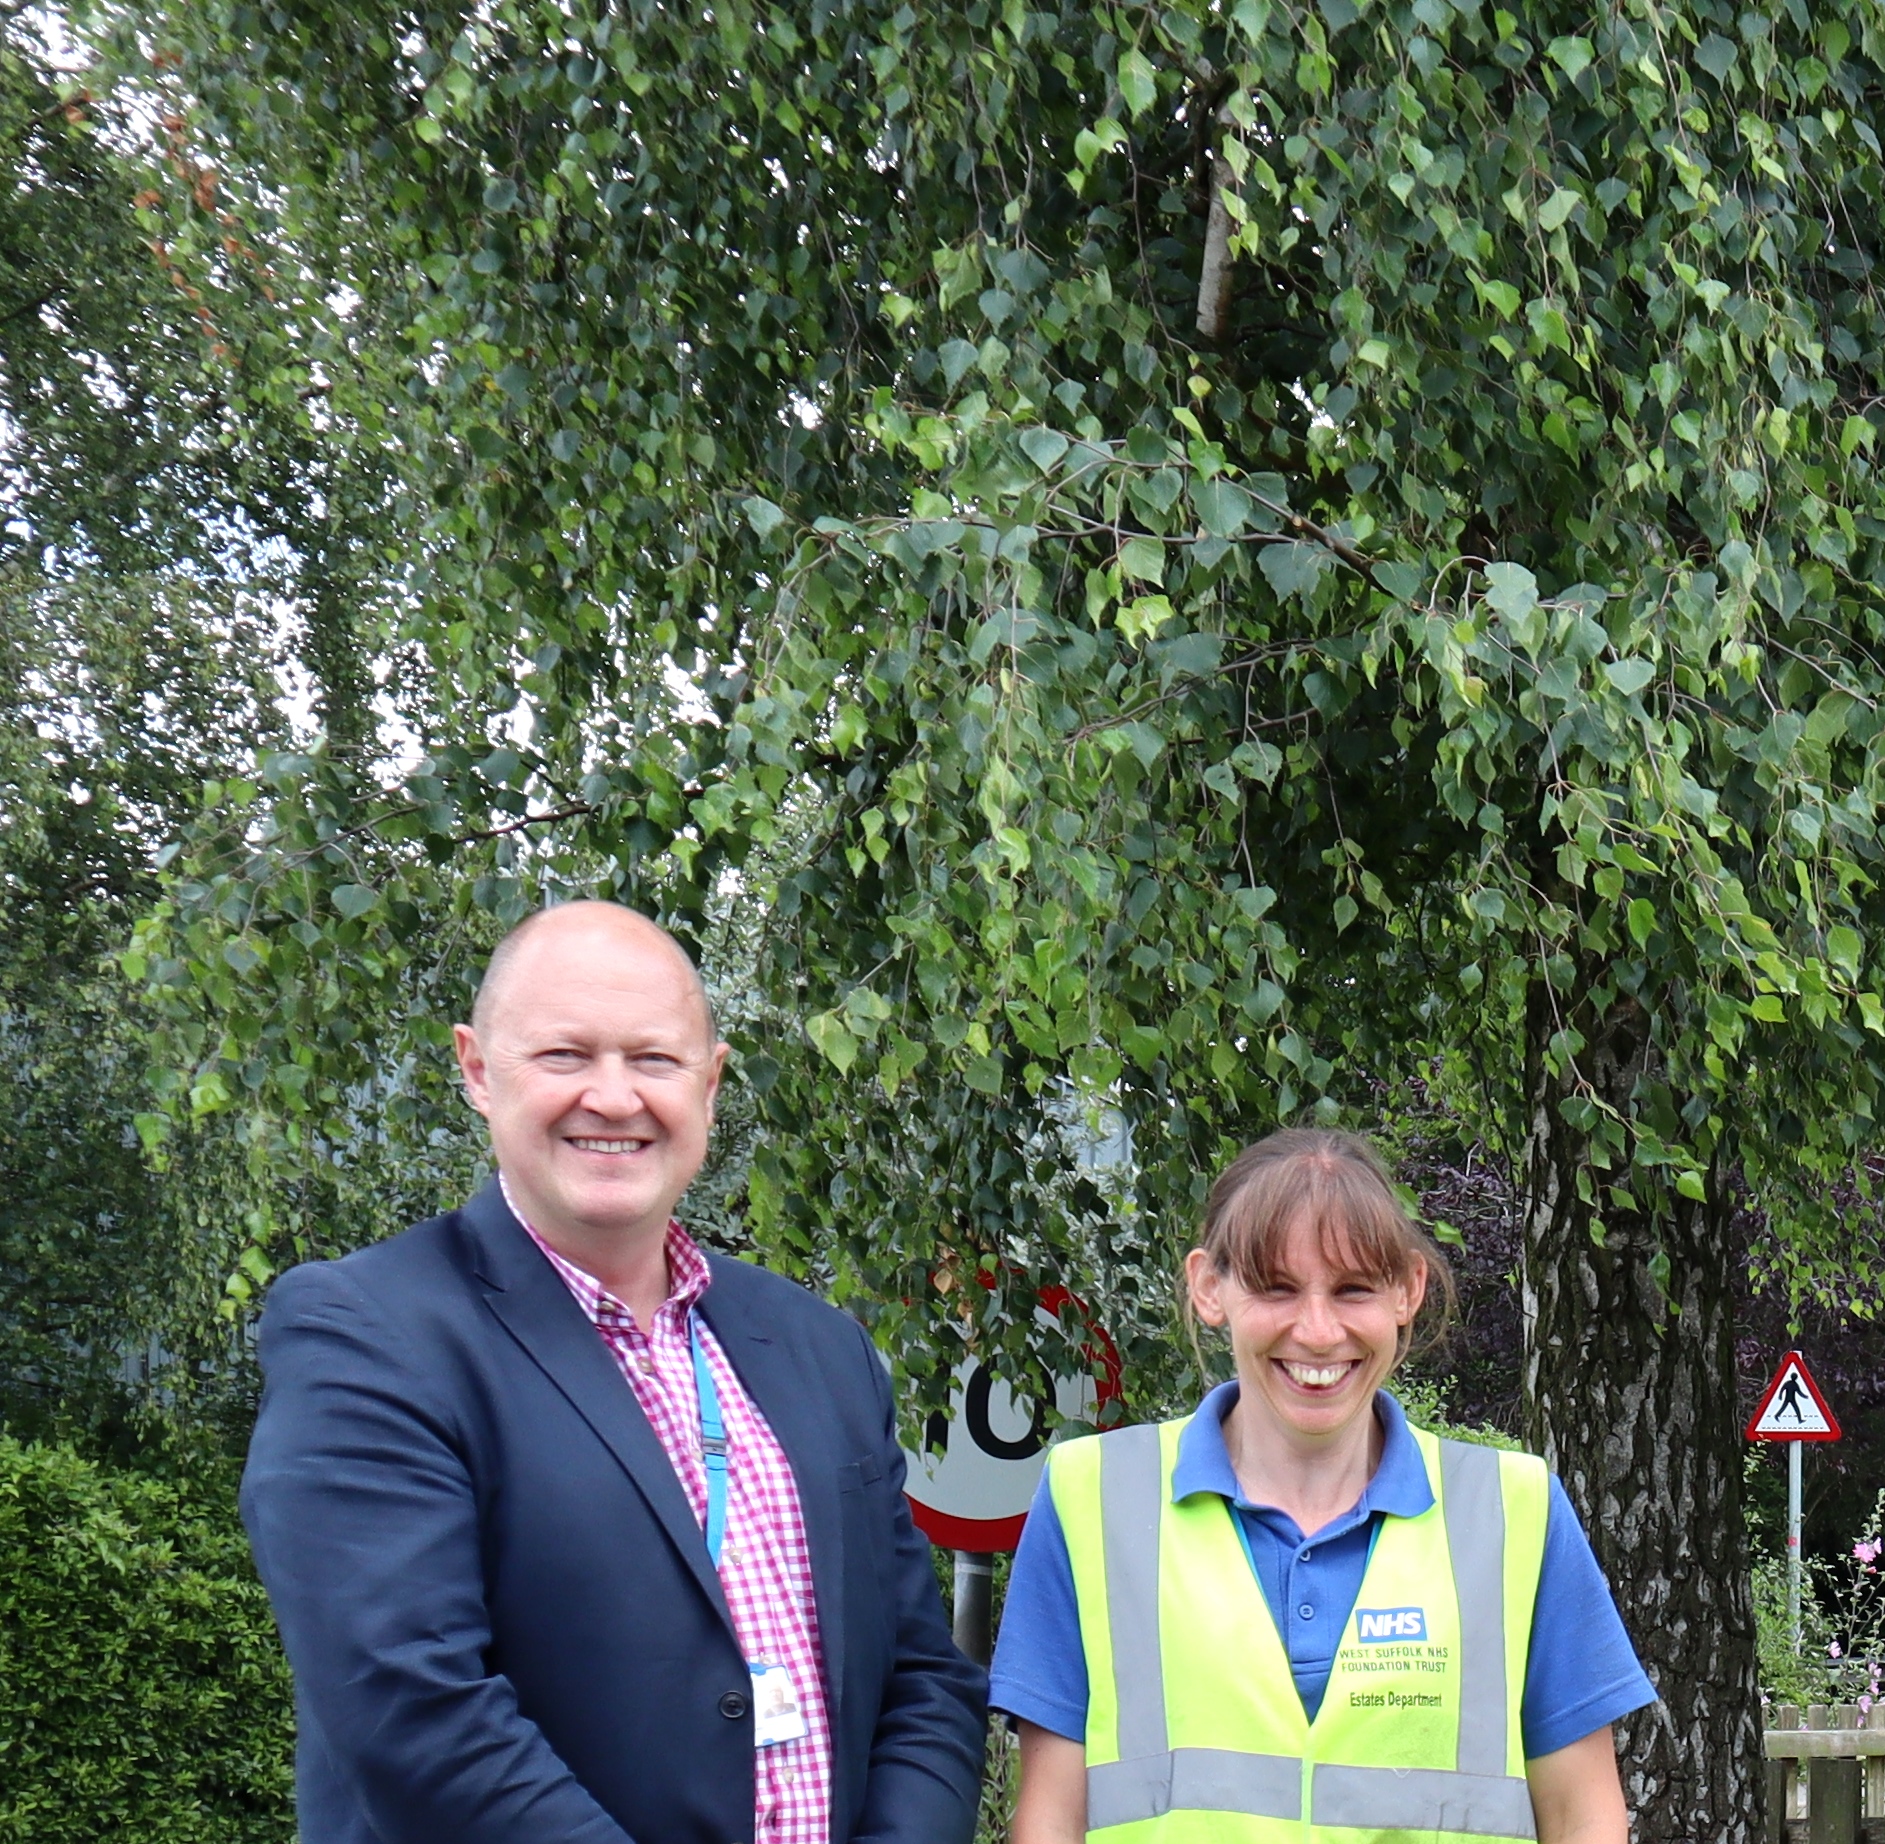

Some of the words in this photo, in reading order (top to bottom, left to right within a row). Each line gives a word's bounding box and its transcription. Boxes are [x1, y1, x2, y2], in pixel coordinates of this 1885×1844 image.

[1360, 1611, 1421, 1637] NHS
[1340, 1649, 1370, 1659] WEST
[1375, 1646, 1423, 1658] SUFFOLK
[1428, 1647, 1448, 1658] NHS
[1341, 1661, 1411, 1673] FOUNDATION
[1415, 1660, 1446, 1673] TRUST
[1350, 1692, 1385, 1707] Estates
[1388, 1691, 1442, 1709] Department
